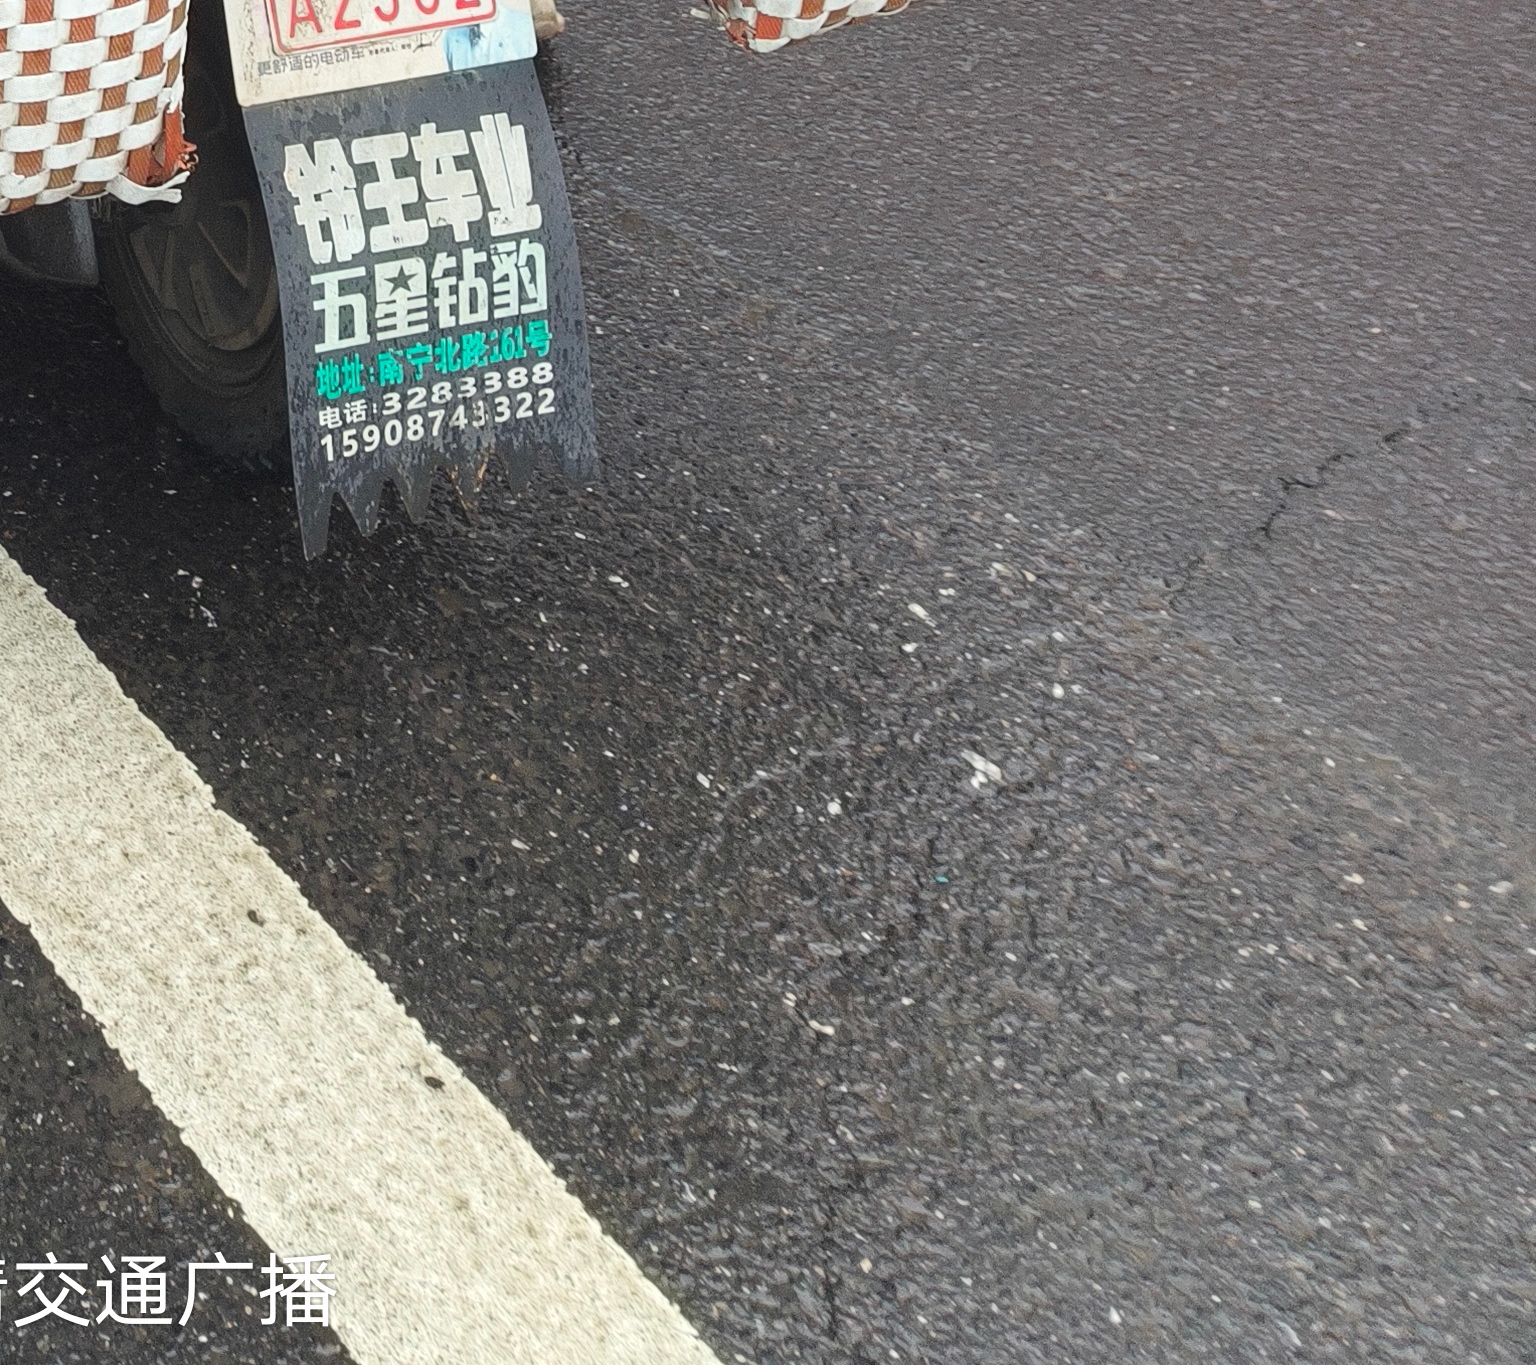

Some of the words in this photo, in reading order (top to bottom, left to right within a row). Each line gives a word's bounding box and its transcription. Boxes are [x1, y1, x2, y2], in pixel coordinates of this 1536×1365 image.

[257, 45, 365, 77] 更舒适的电动车
[310, 238, 548, 354] 五星钻豹
[318, 361, 555, 430] 电话:3283388
